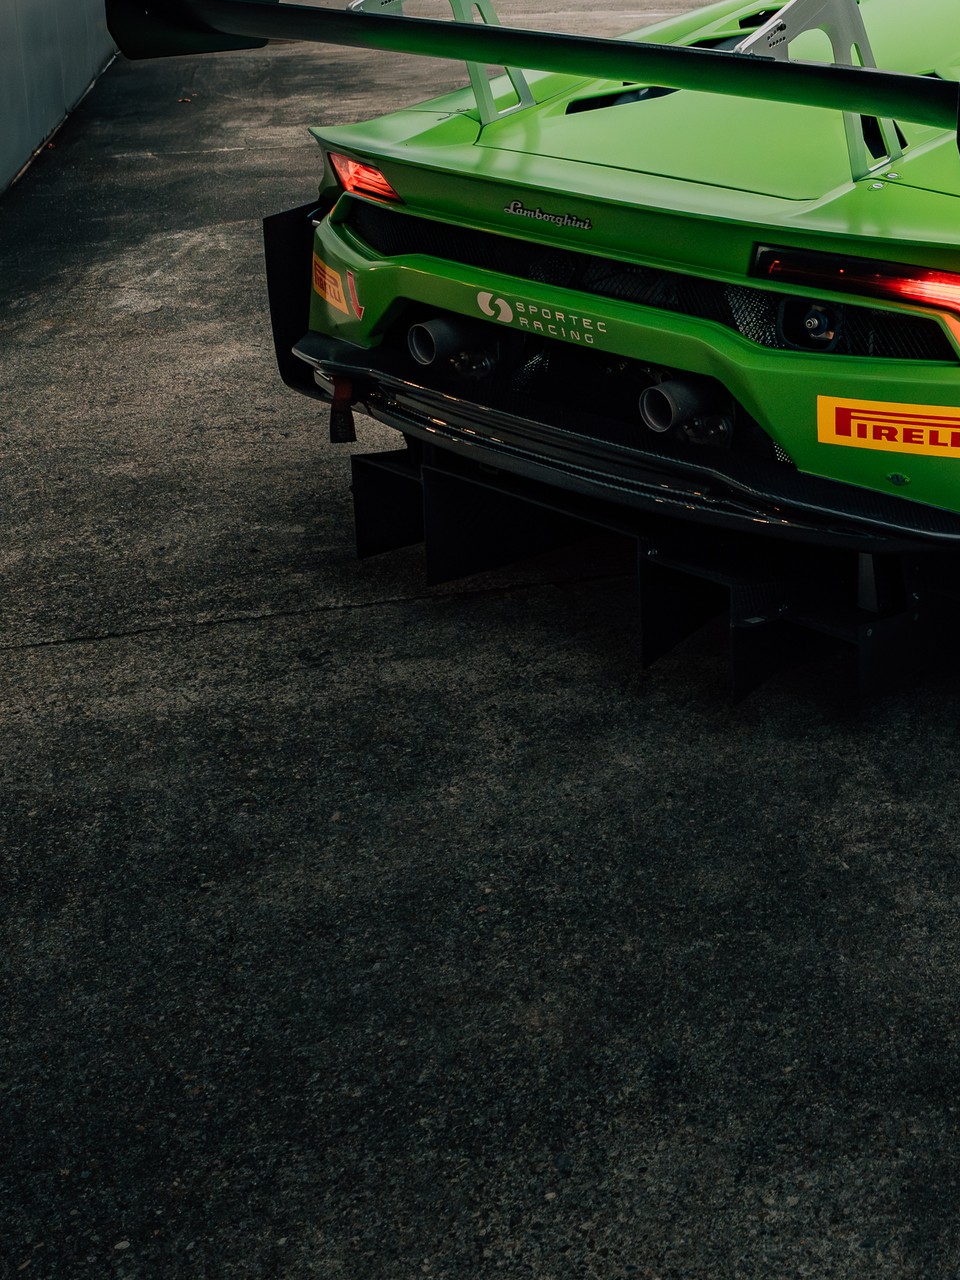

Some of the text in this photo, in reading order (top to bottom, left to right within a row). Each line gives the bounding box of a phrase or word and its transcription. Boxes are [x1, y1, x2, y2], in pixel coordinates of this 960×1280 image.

[504, 200, 592, 231] Lamborghini
[515, 301, 608, 333] SPORTEC
[519, 317, 595, 345] RACING
